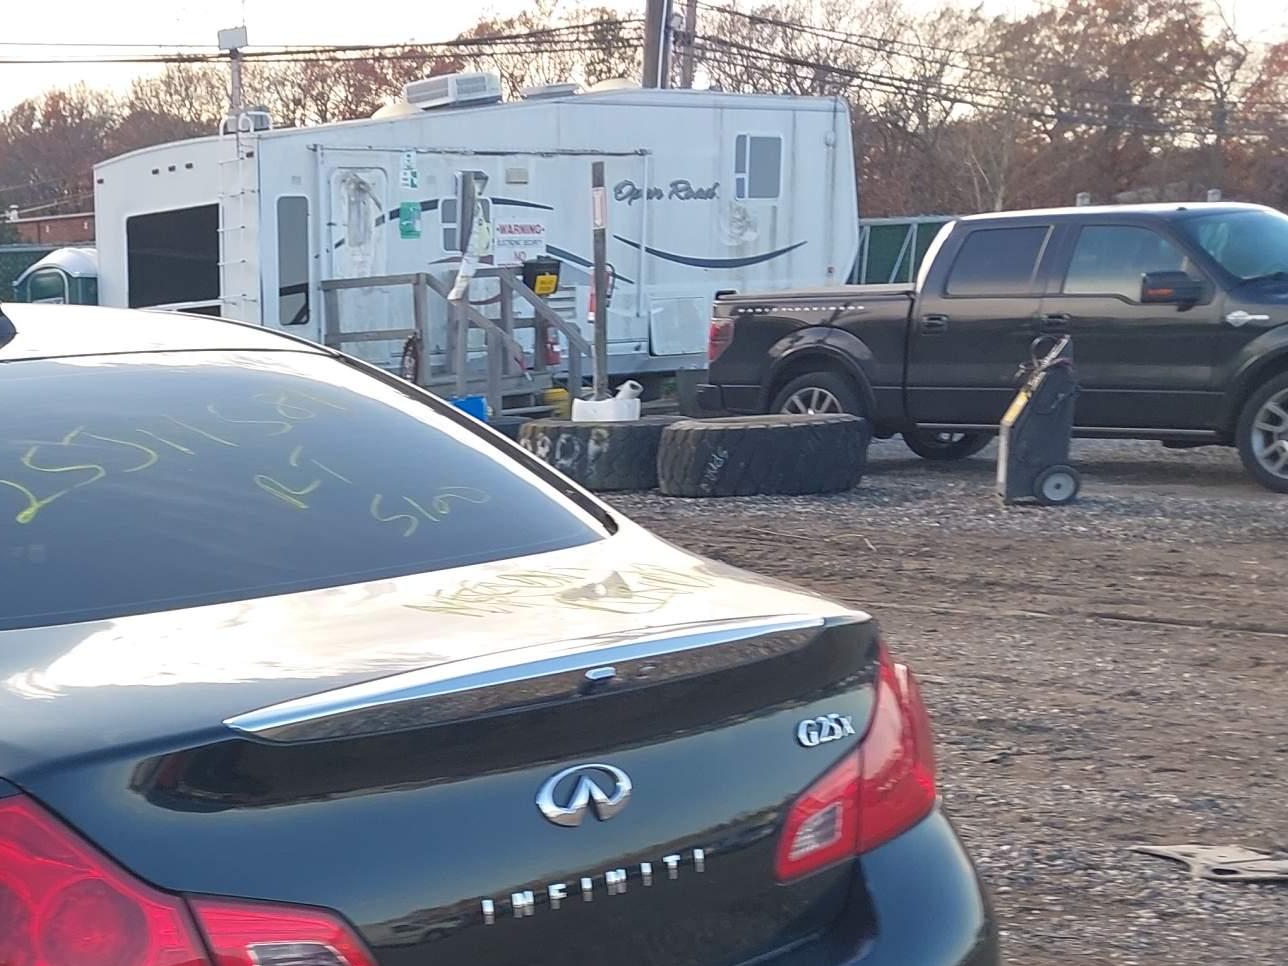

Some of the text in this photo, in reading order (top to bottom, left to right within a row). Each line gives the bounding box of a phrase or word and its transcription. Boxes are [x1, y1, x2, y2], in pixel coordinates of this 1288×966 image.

[613, 179, 721, 206] Open Road
[499, 223, 542, 235] WARNING
[481, 847, 706, 925] INFINITI
